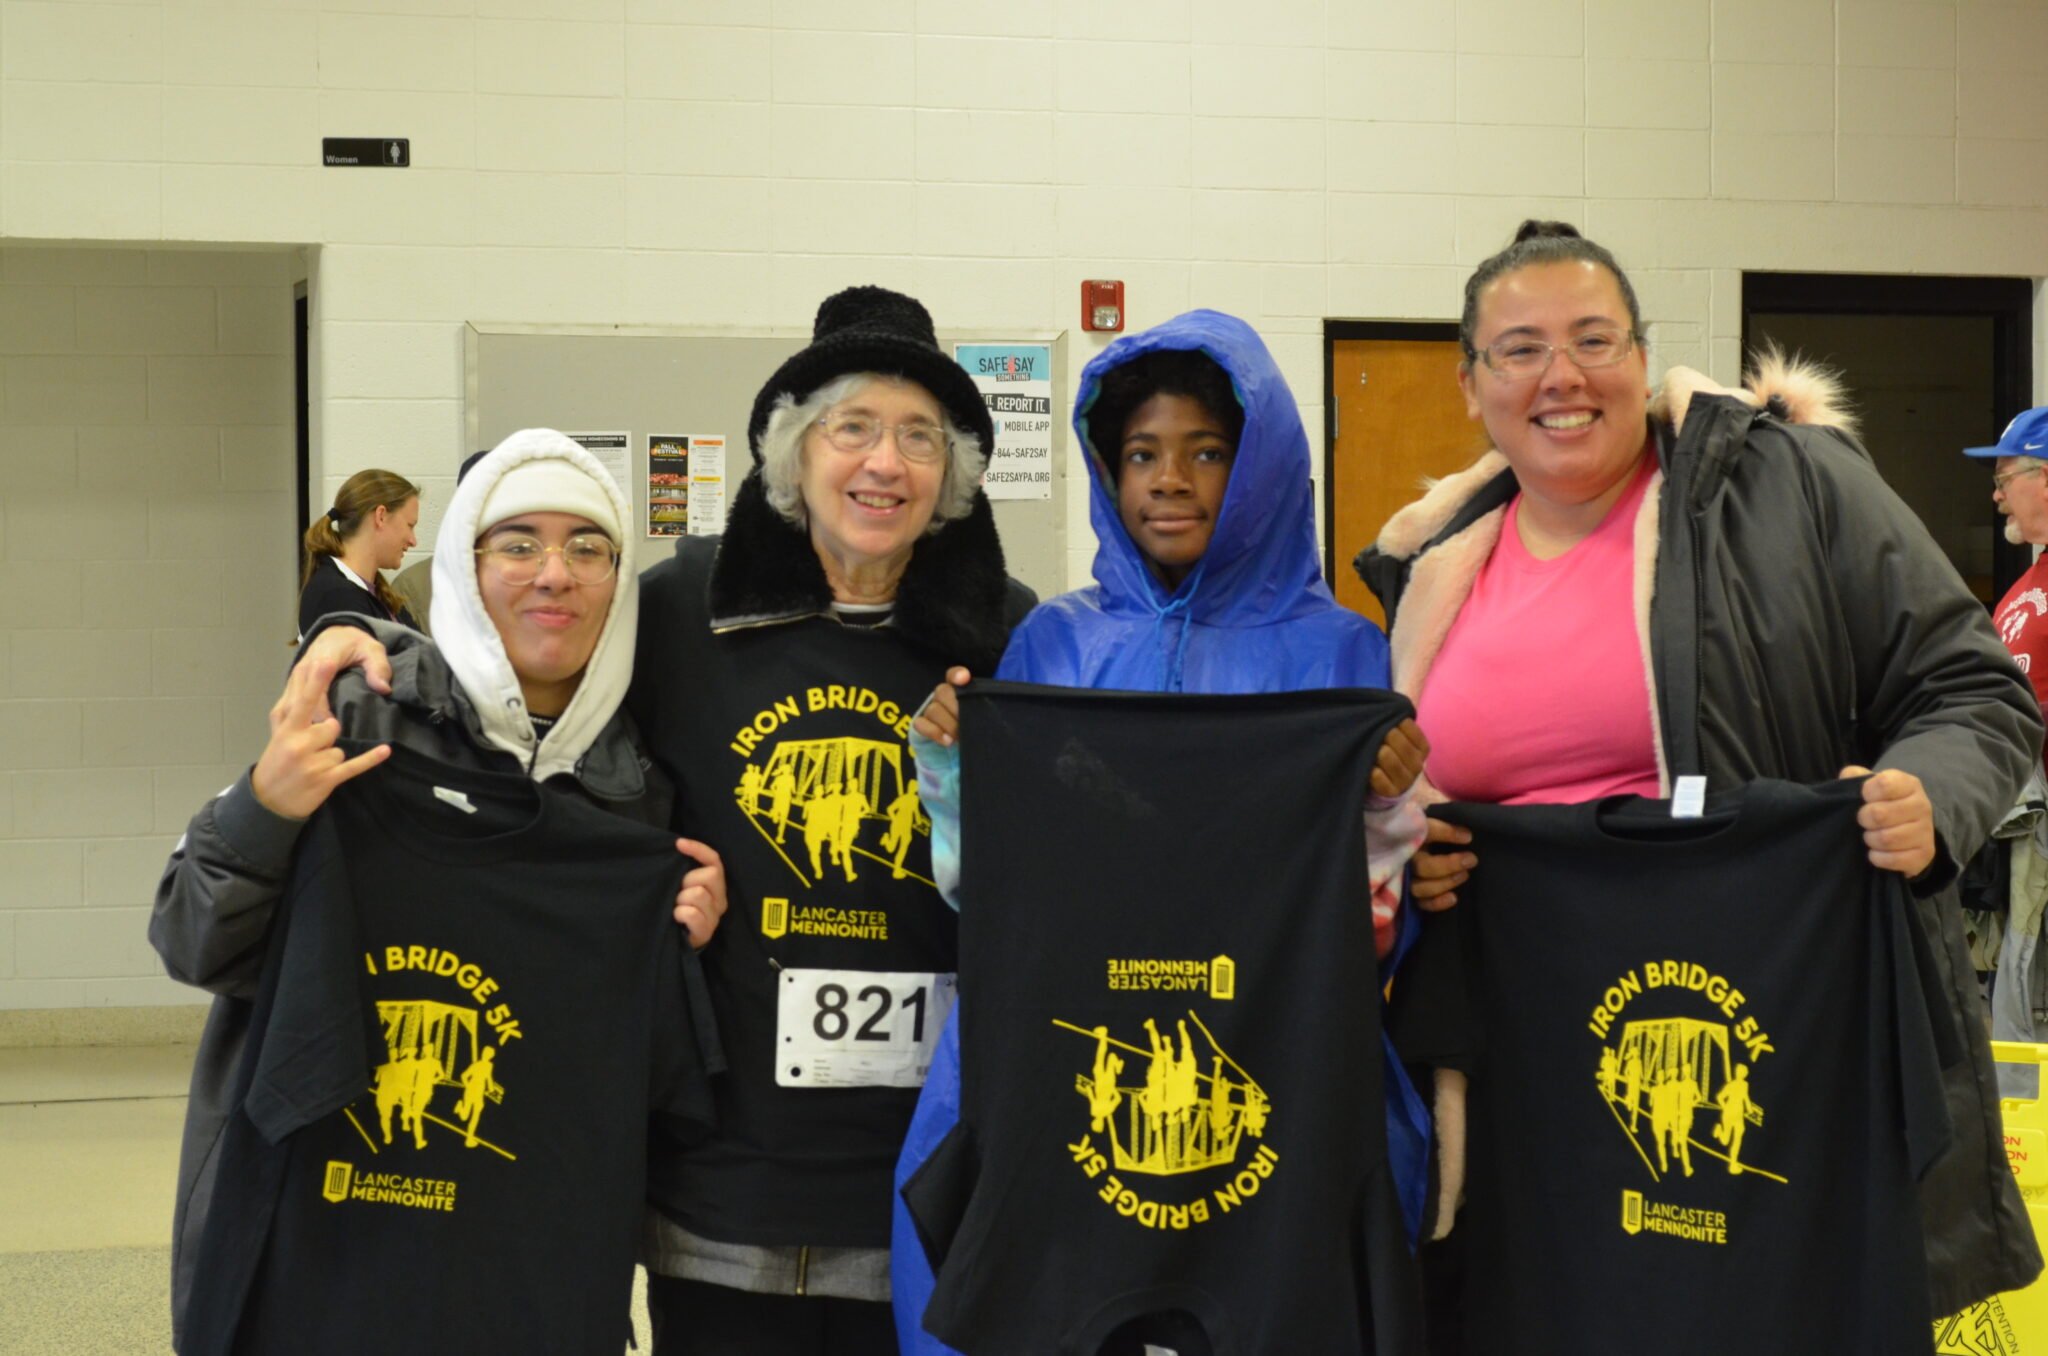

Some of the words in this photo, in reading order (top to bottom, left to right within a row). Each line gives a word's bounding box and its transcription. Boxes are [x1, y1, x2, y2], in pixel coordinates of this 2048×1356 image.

[325, 155, 358, 164] Women
[979, 356, 1008, 372] SAFE
[1014, 356, 1035, 372] SAY
[997, 397, 1033, 411] REPORT
[1036, 399, 1045, 412] IT.
[1004, 421, 1033, 431] MOBILE
[1035, 421, 1050, 431] APP
[993, 447, 1048, 458] -844-SAF2SAY
[986, 472, 1050, 483] SAFE2SAYPA.ORG
[730, 695, 801, 758] IRON
[806, 685, 914, 739] BRIDGE
[791, 905, 887, 925] LANCASTER
[790, 921, 888, 940] MENNONITE
[1107, 959, 1208, 976] MENNONITE
[385, 945, 499, 1004] BRIDGE
[485, 1003, 522, 1046] 5K
[1108, 975, 1208, 991] LANCASTER
[813, 983, 927, 1042] 821
[1588, 970, 1643, 1040] IRON
[1644, 960, 1746, 1019] BRIDGE
[1734, 1016, 1775, 1062] 5K
[1068, 1134, 1107, 1178] 5K
[354, 1170, 457, 1196] LANCASTER
[1213, 1144, 1279, 1213] IRON
[351, 1186, 455, 1211] MENNONITE
[1098, 1175, 1210, 1230] BRIDGE
[1645, 1200, 1726, 1228] LANCASTER
[1644, 1216, 1727, 1244] MENNONITE
[1990, 1293, 2020, 1354] TENTION
